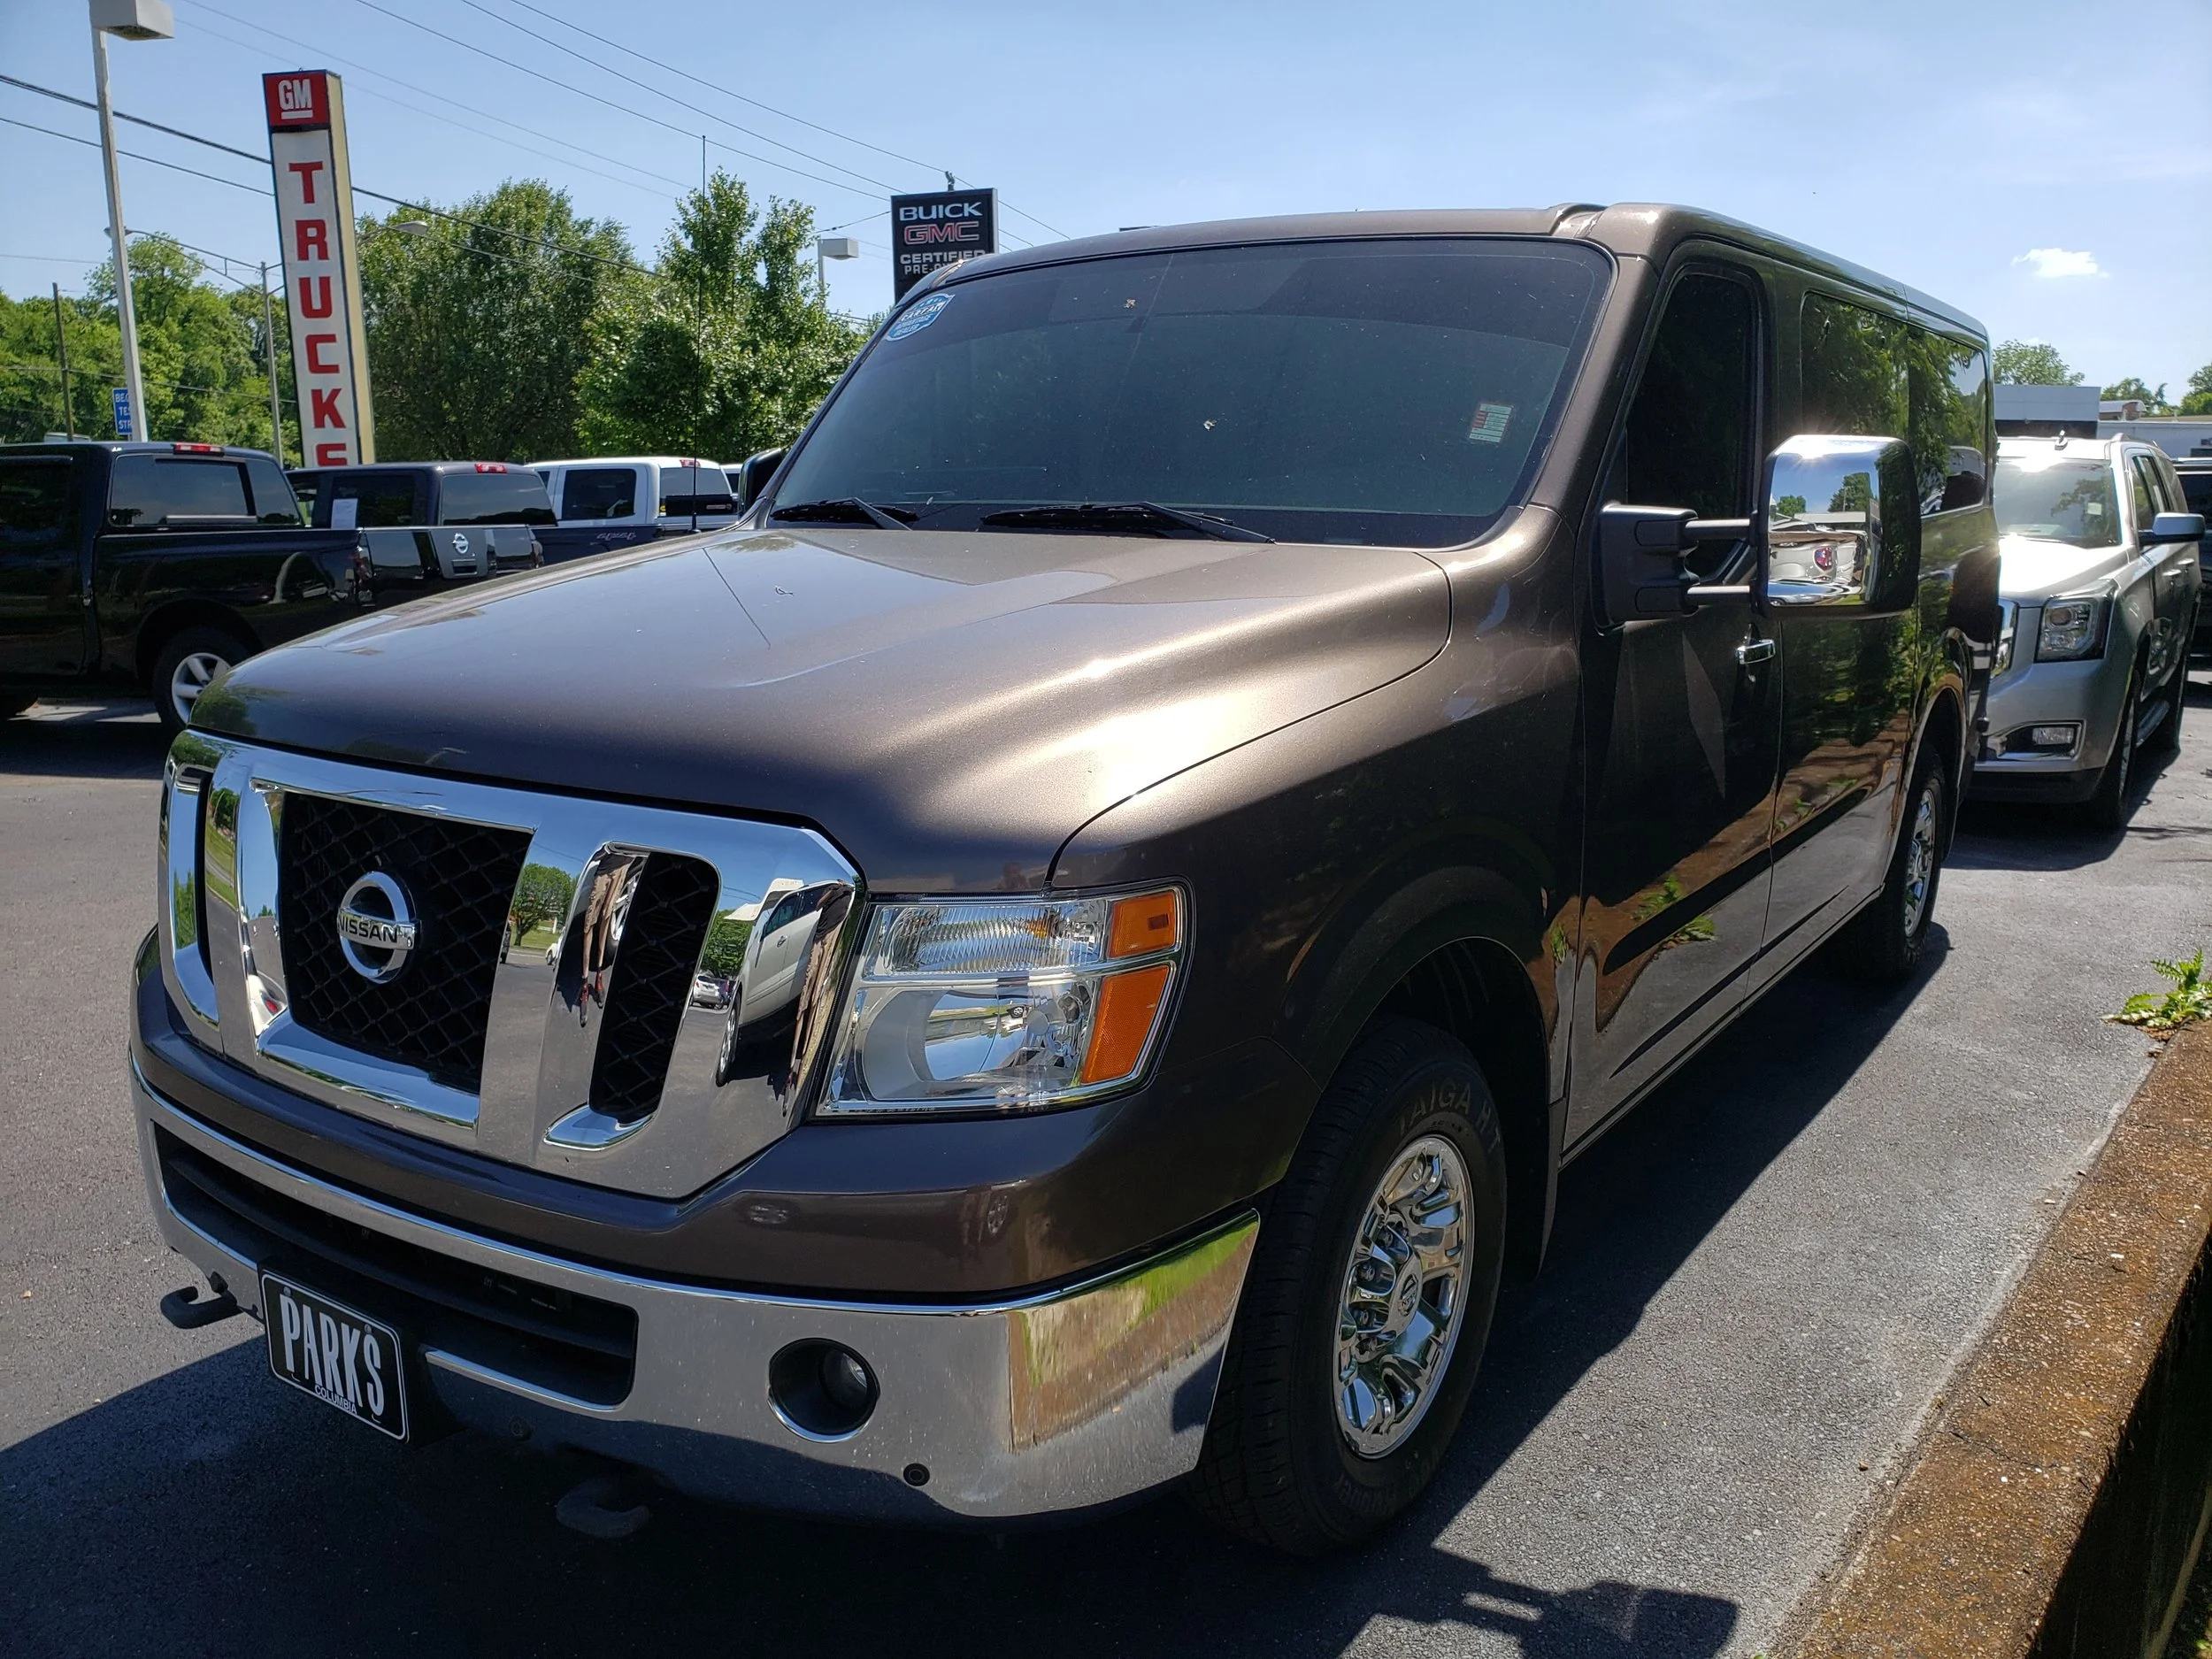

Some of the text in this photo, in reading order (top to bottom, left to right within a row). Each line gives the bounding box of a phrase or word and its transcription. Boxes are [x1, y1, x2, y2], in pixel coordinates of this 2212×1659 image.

[278, 78, 312, 111] GM
[899, 202, 983, 221] BUICK
[903, 220, 979, 245] GMC
[337, 913, 397, 944] NISSAN
[280, 1294, 384, 1416] PARKS
[315, 1384, 357, 1415] COLUMBIA
